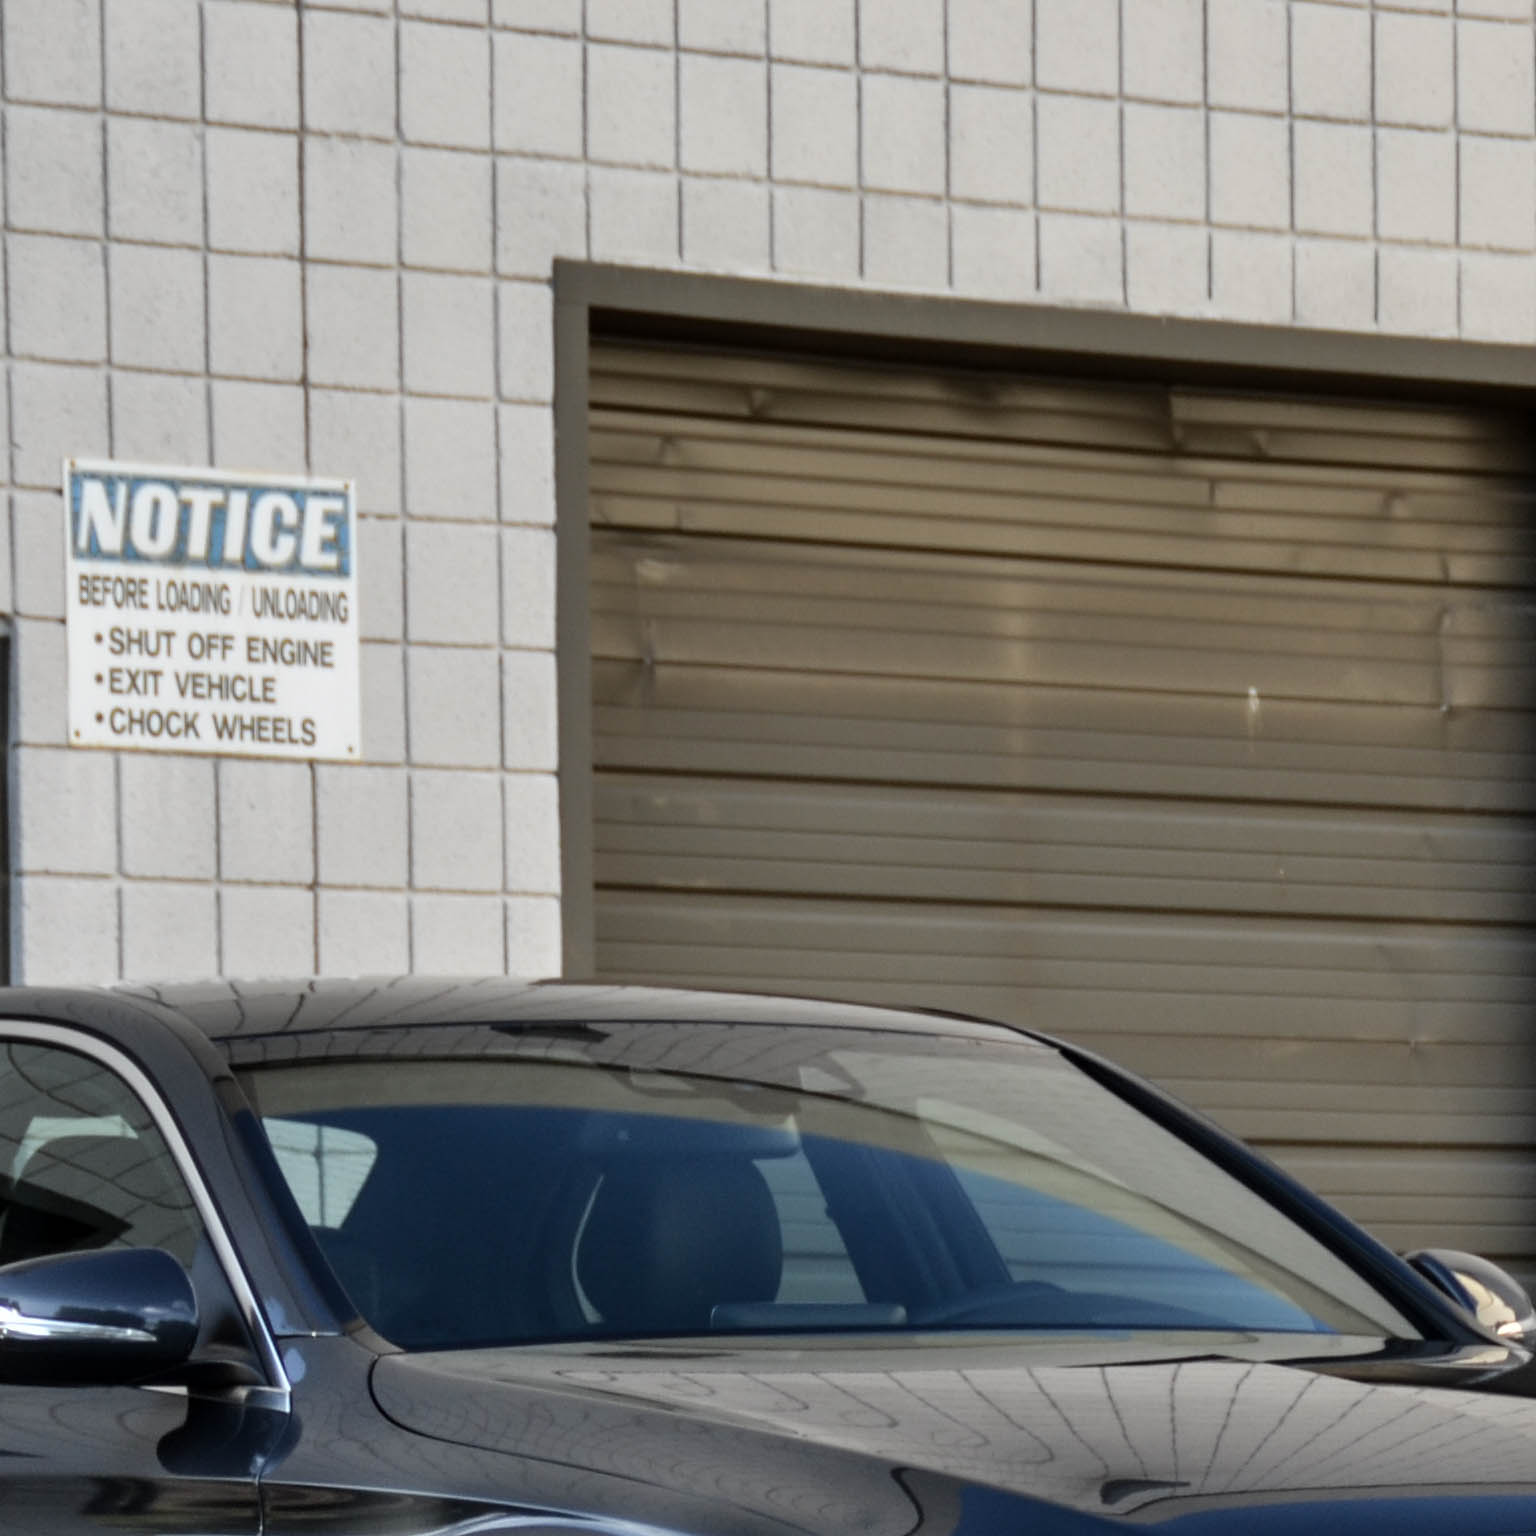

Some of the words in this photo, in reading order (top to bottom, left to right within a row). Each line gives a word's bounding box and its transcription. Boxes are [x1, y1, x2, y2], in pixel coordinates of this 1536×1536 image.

[76, 478, 346, 570] NOTICE
[78, 573, 150, 610] BEFORE
[156, 579, 232, 616] LOADING
[251, 586, 349, 625] UNLOADING
[108, 626, 177, 659] SHUT
[186, 631, 236, 661] OFF
[245, 635, 335, 669] ENGINE
[108, 666, 164, 697] EXIT
[174, 671, 277, 705] VEHICLE
[108, 706, 201, 740] CHOCK
[211, 712, 317, 747] WHEELS
